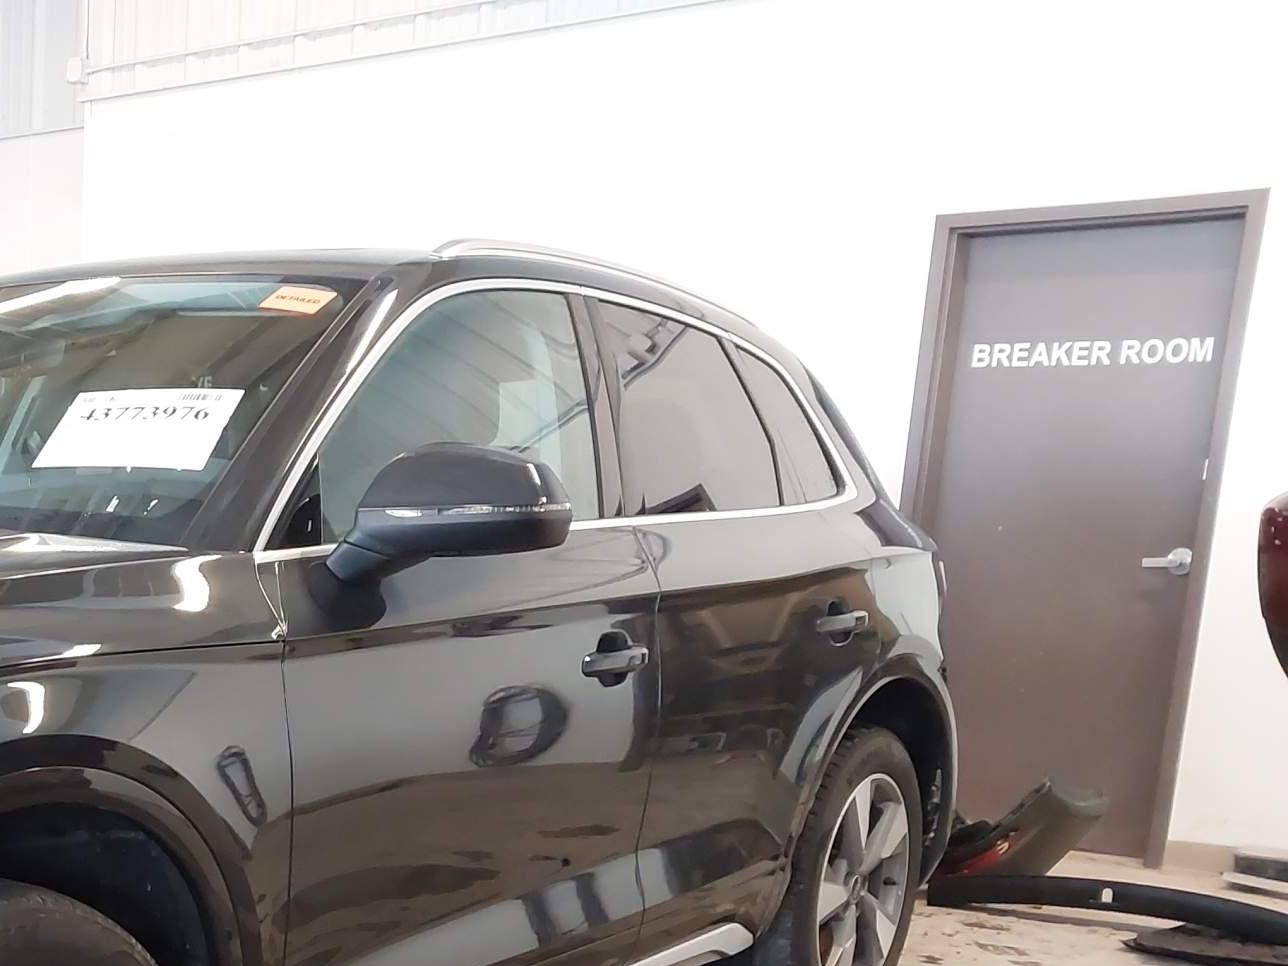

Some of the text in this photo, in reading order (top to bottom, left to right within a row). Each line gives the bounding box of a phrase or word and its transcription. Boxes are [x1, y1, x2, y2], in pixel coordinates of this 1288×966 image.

[970, 336, 1215, 368] BREAKER ROOM
[80, 405, 211, 422] 43773976
